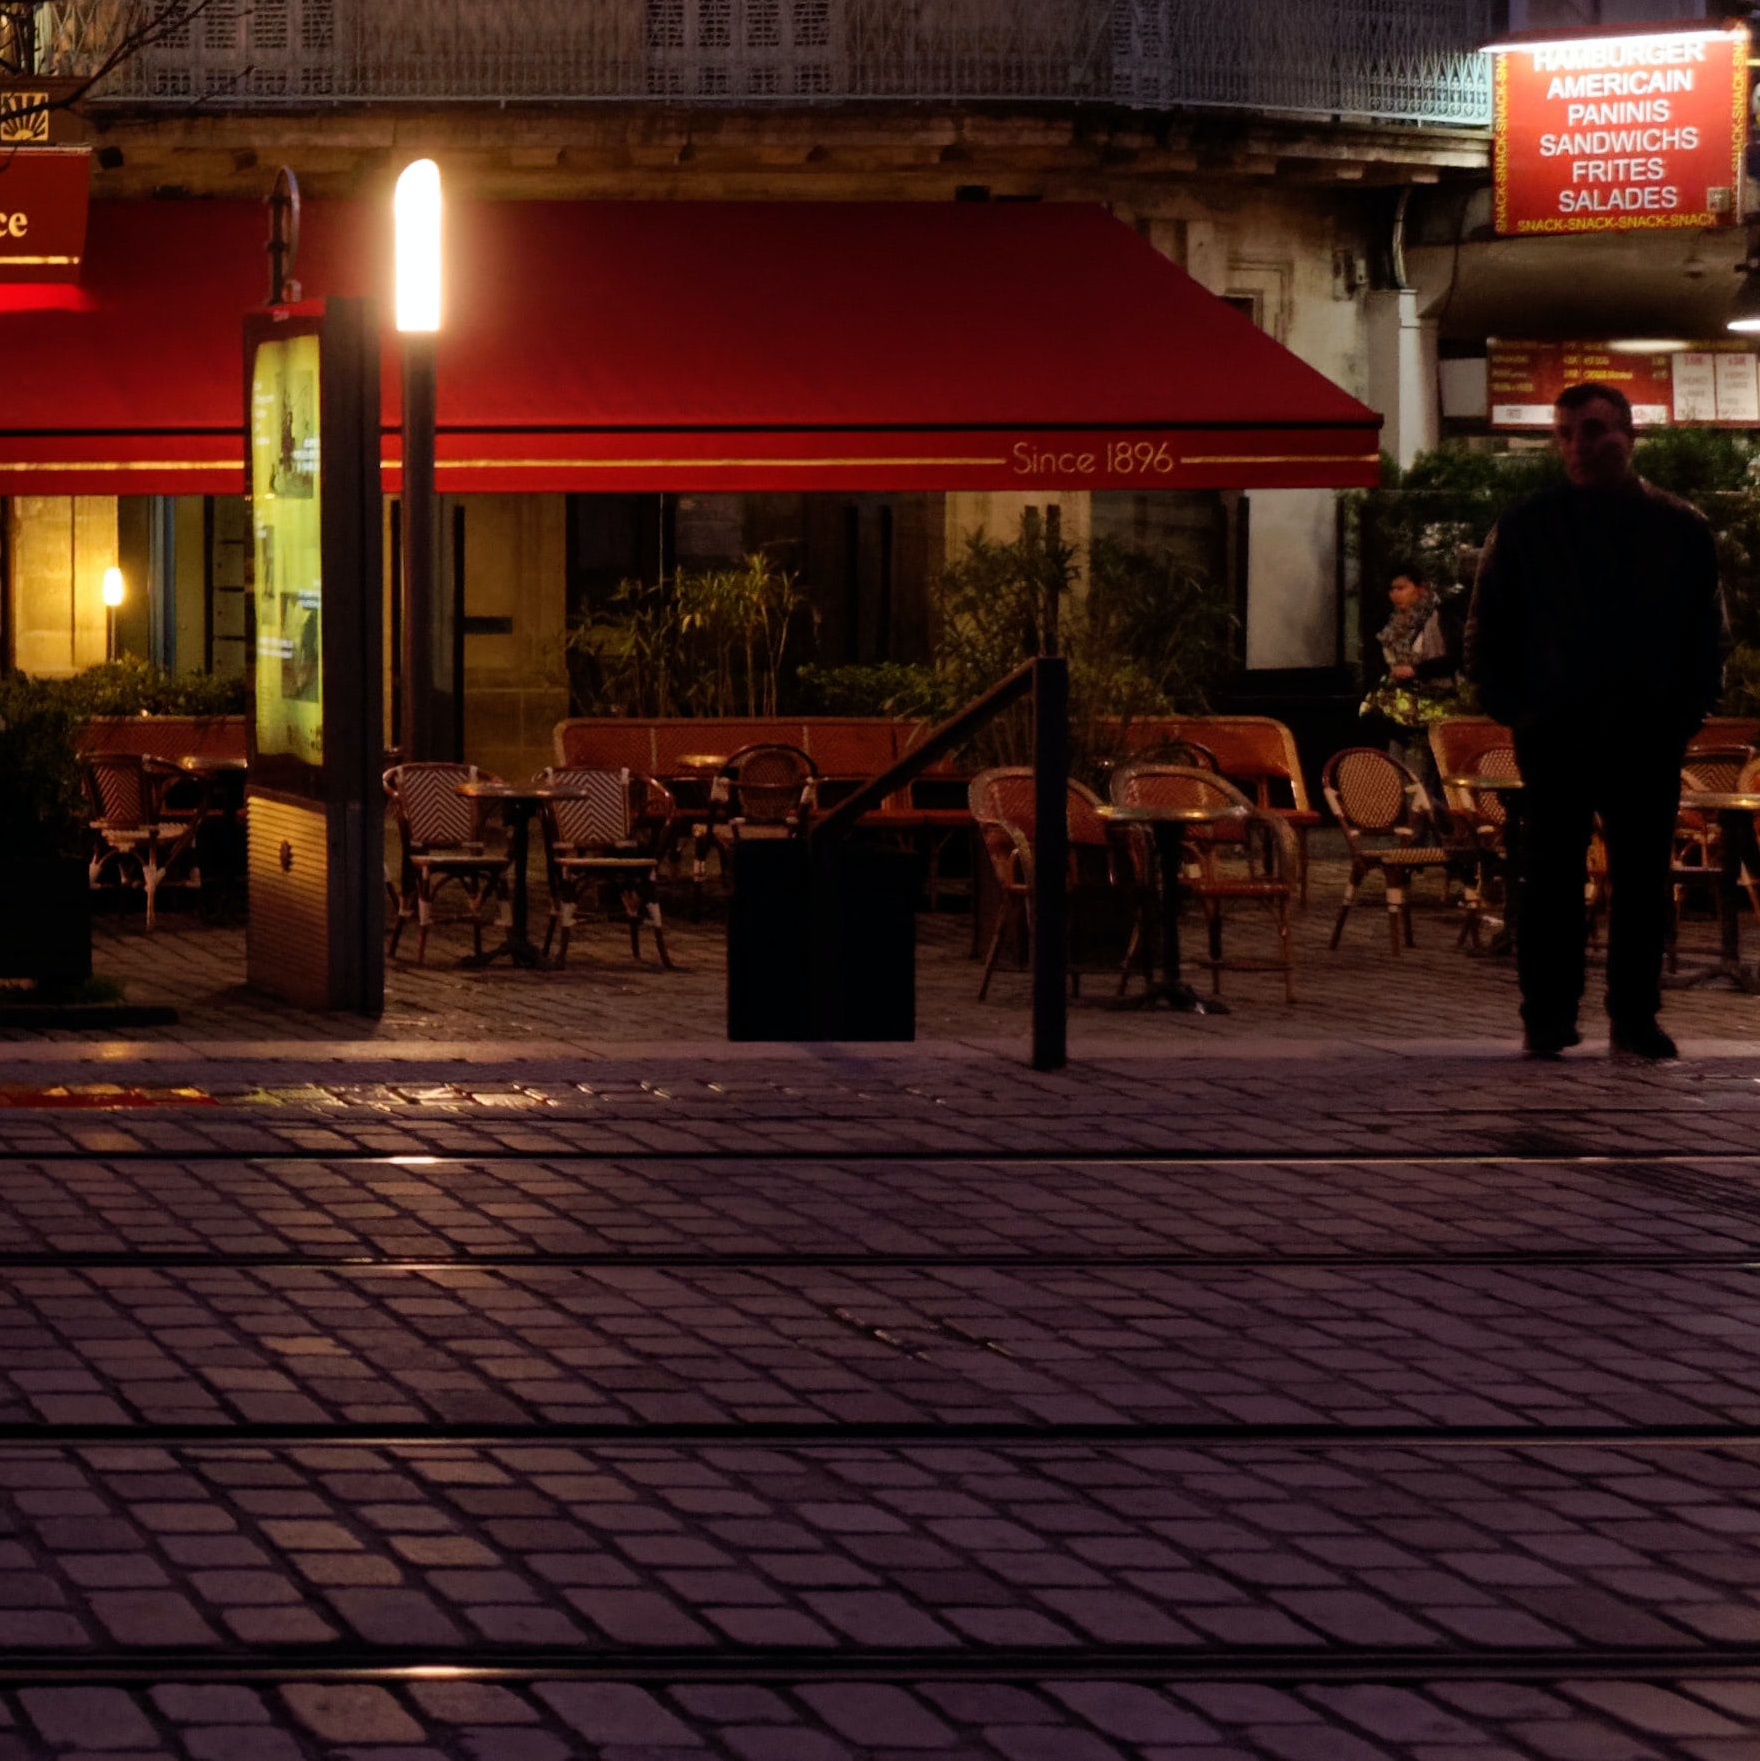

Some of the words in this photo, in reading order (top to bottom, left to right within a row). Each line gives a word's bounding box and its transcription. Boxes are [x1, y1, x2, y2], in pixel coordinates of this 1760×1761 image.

[1533, 40, 1705, 71] HAMBURGER
[1546, 69, 1693, 100] AMERICAIN
[1568, 99, 1670, 127] PANINIS
[1539, 127, 1699, 157] SANDWICHS
[1572, 157, 1664, 183] FRITES
[1559, 187, 1678, 213] SALADES
[1013, 442, 1095, 474] Since
[1107, 441, 1174, 474] 1896
